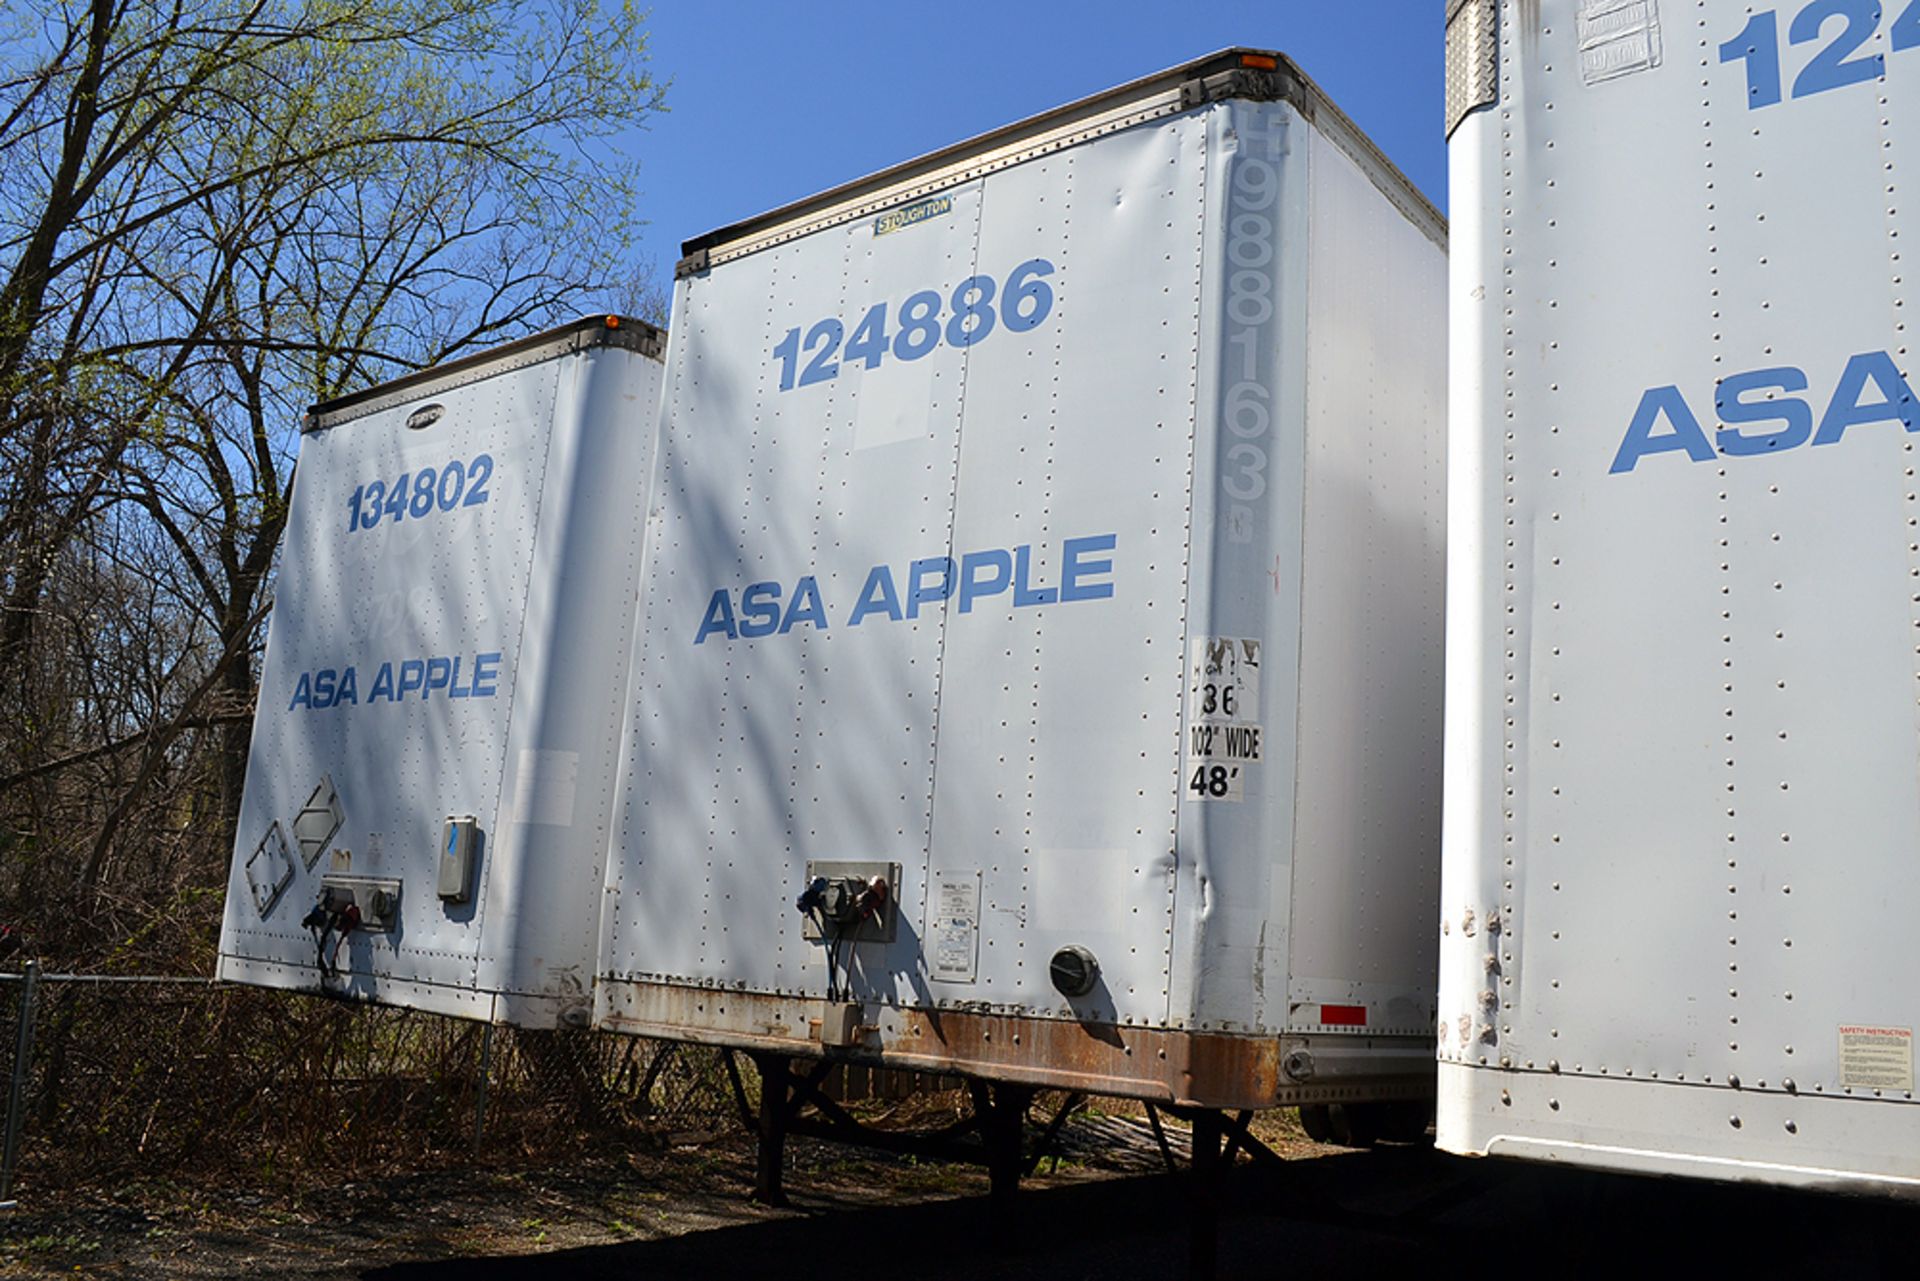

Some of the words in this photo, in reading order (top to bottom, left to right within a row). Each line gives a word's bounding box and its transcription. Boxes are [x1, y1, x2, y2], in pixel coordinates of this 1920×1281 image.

[878, 195, 952, 231] STOUGHTON
[773, 258, 1055, 392] 124886
[1608, 350, 1920, 475] ASA
[347, 454, 494, 532] 134802
[693, 576, 829, 645] ASA
[847, 534, 1117, 627] APPLE
[288, 667, 358, 711] ASA
[367, 652, 502, 704] APPLE
[1225, 726, 1260, 760] WIDE
[1190, 765, 1239, 797] 48'
[1839, 1026, 1865, 1035] SAFETY
